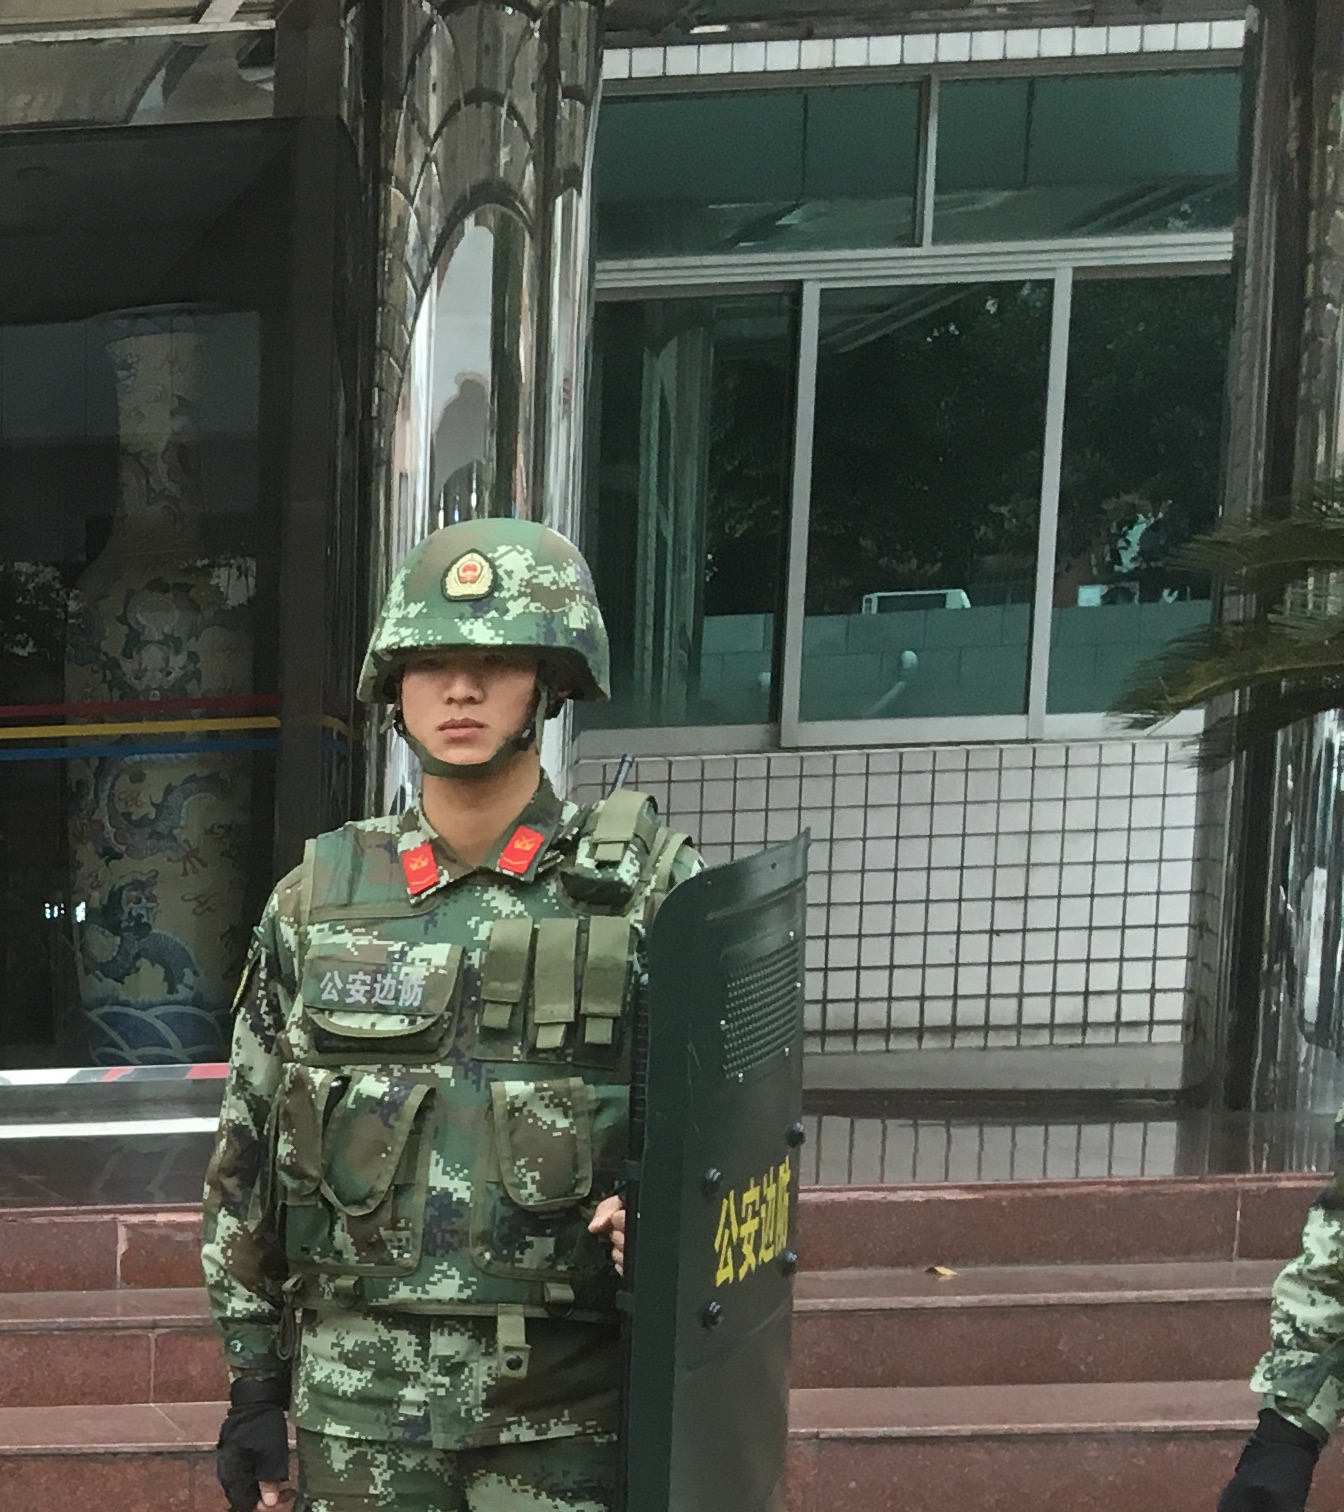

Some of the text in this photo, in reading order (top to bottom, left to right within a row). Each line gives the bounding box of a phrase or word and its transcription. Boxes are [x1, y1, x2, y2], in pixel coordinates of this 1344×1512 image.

[319, 970, 426, 1007] 公安边防
[714, 1154, 791, 1288] 公安边防
